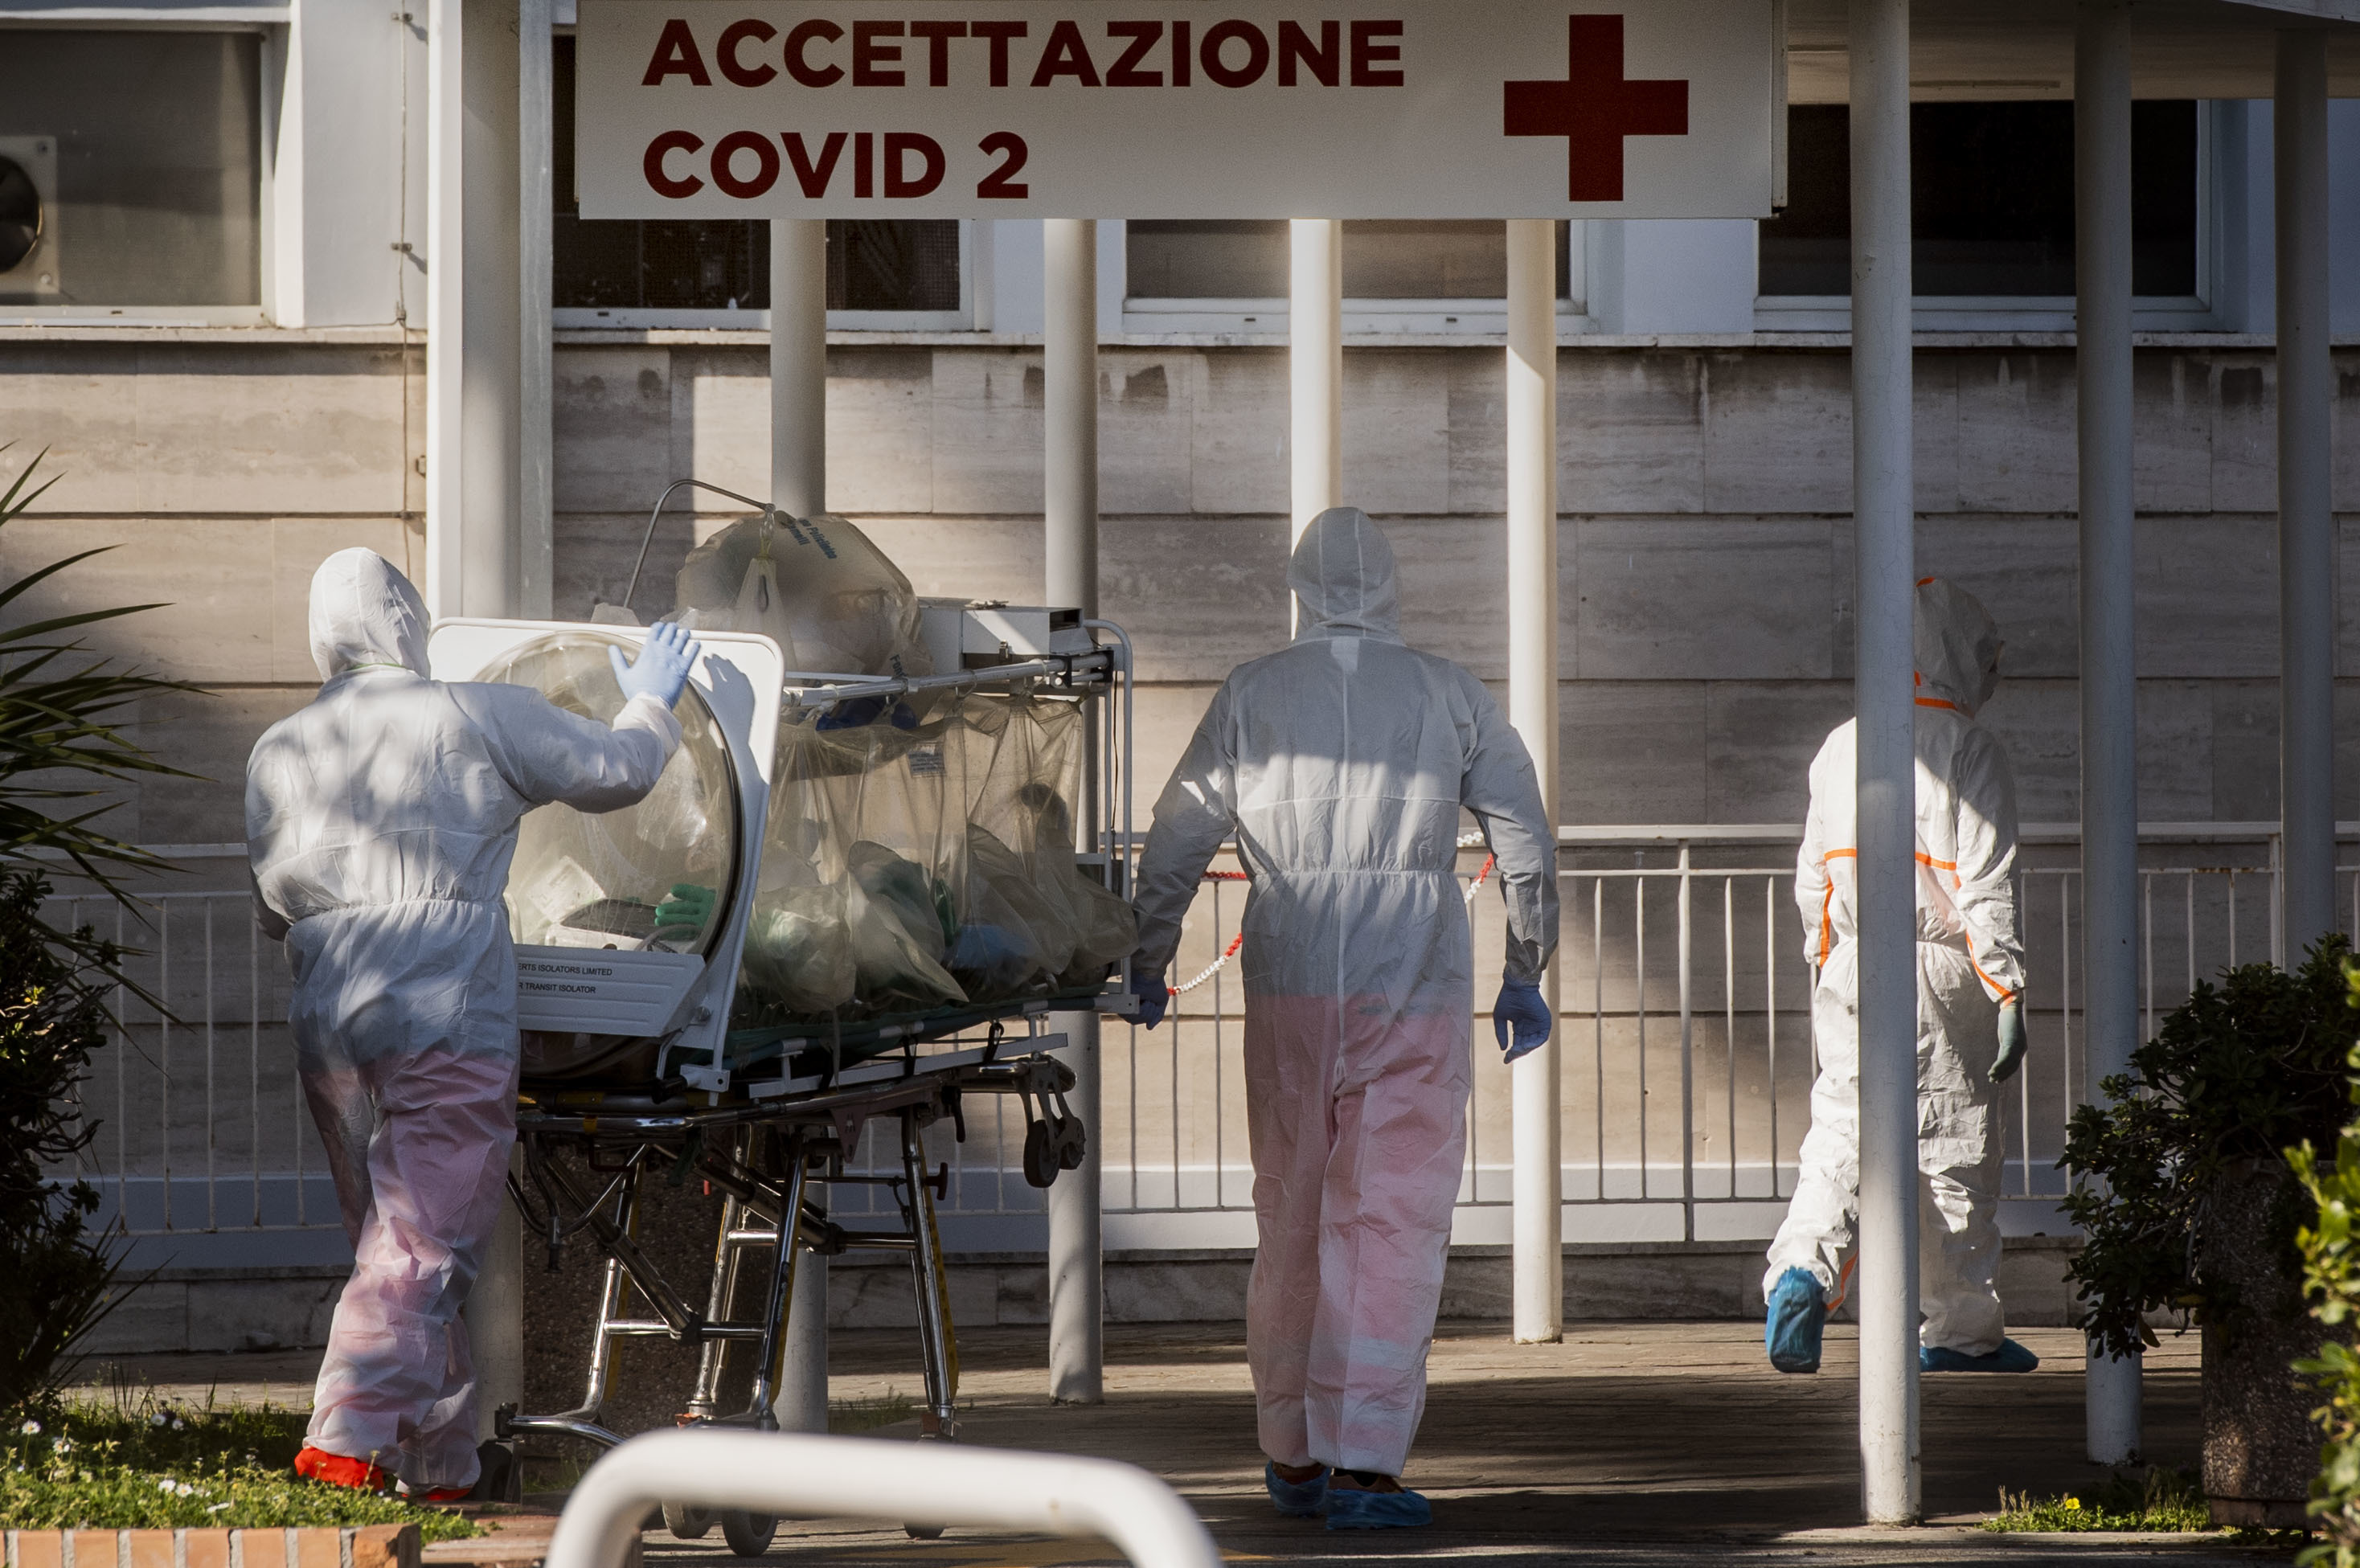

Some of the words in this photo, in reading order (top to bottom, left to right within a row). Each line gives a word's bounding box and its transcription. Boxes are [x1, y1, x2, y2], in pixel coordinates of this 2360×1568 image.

[641, 19, 1404, 88] ACCETTAZIONE
[644, 130, 945, 199] COVID
[976, 131, 1028, 199] 2
[525, 981, 558, 991] TRANSIT
[559, 984, 596, 993] ISOLATOR
[538, 964, 580, 974] ISOLATORS
[581, 967, 613, 976] LIMITED
